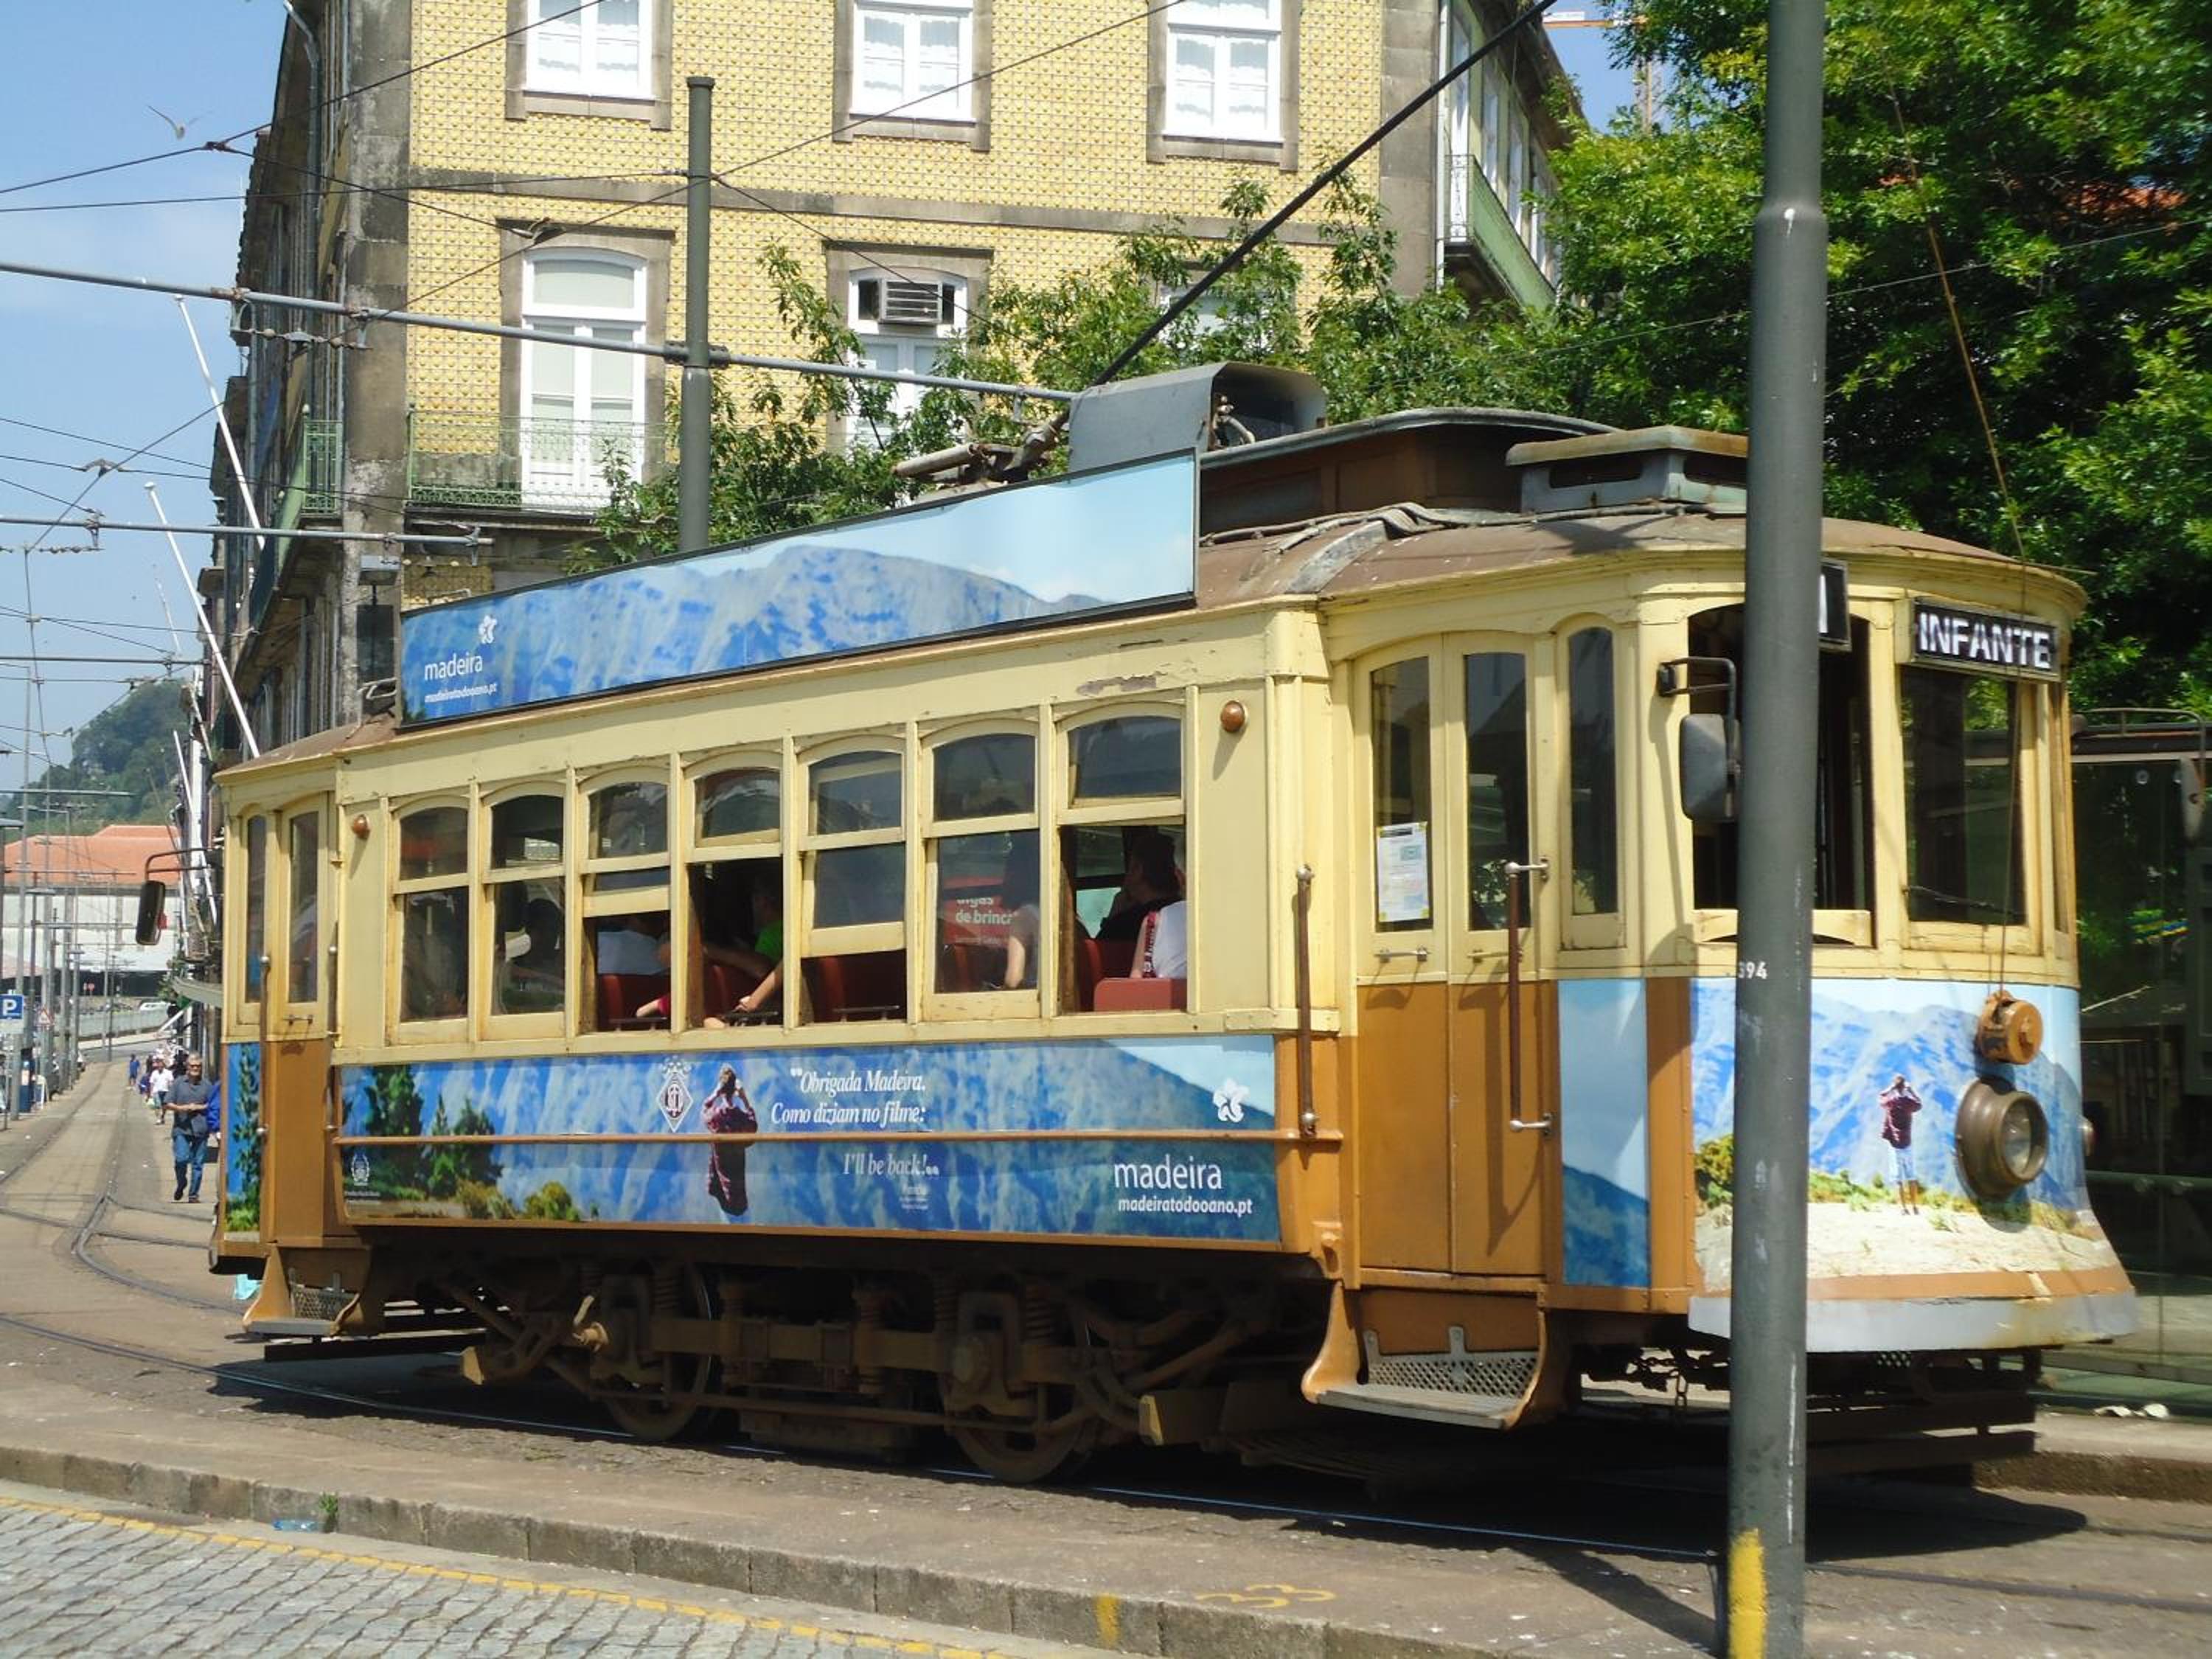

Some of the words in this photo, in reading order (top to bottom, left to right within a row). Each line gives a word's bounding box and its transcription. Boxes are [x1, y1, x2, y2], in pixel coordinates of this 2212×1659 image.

[1918, 611, 2051, 669] INFANTE
[425, 653, 484, 680] madeira
[3, 999, 17, 1016] P
[771, 1102, 810, 1124] Como
[813, 1102, 859, 1125] diziam
[861, 1107, 880, 1123] no
[843, 1152, 865, 1175] I'll
[869, 1152, 884, 1175] be
[1114, 1154, 1222, 1189] madeira
[1119, 1194, 1252, 1217] madeiratodooano.pt
